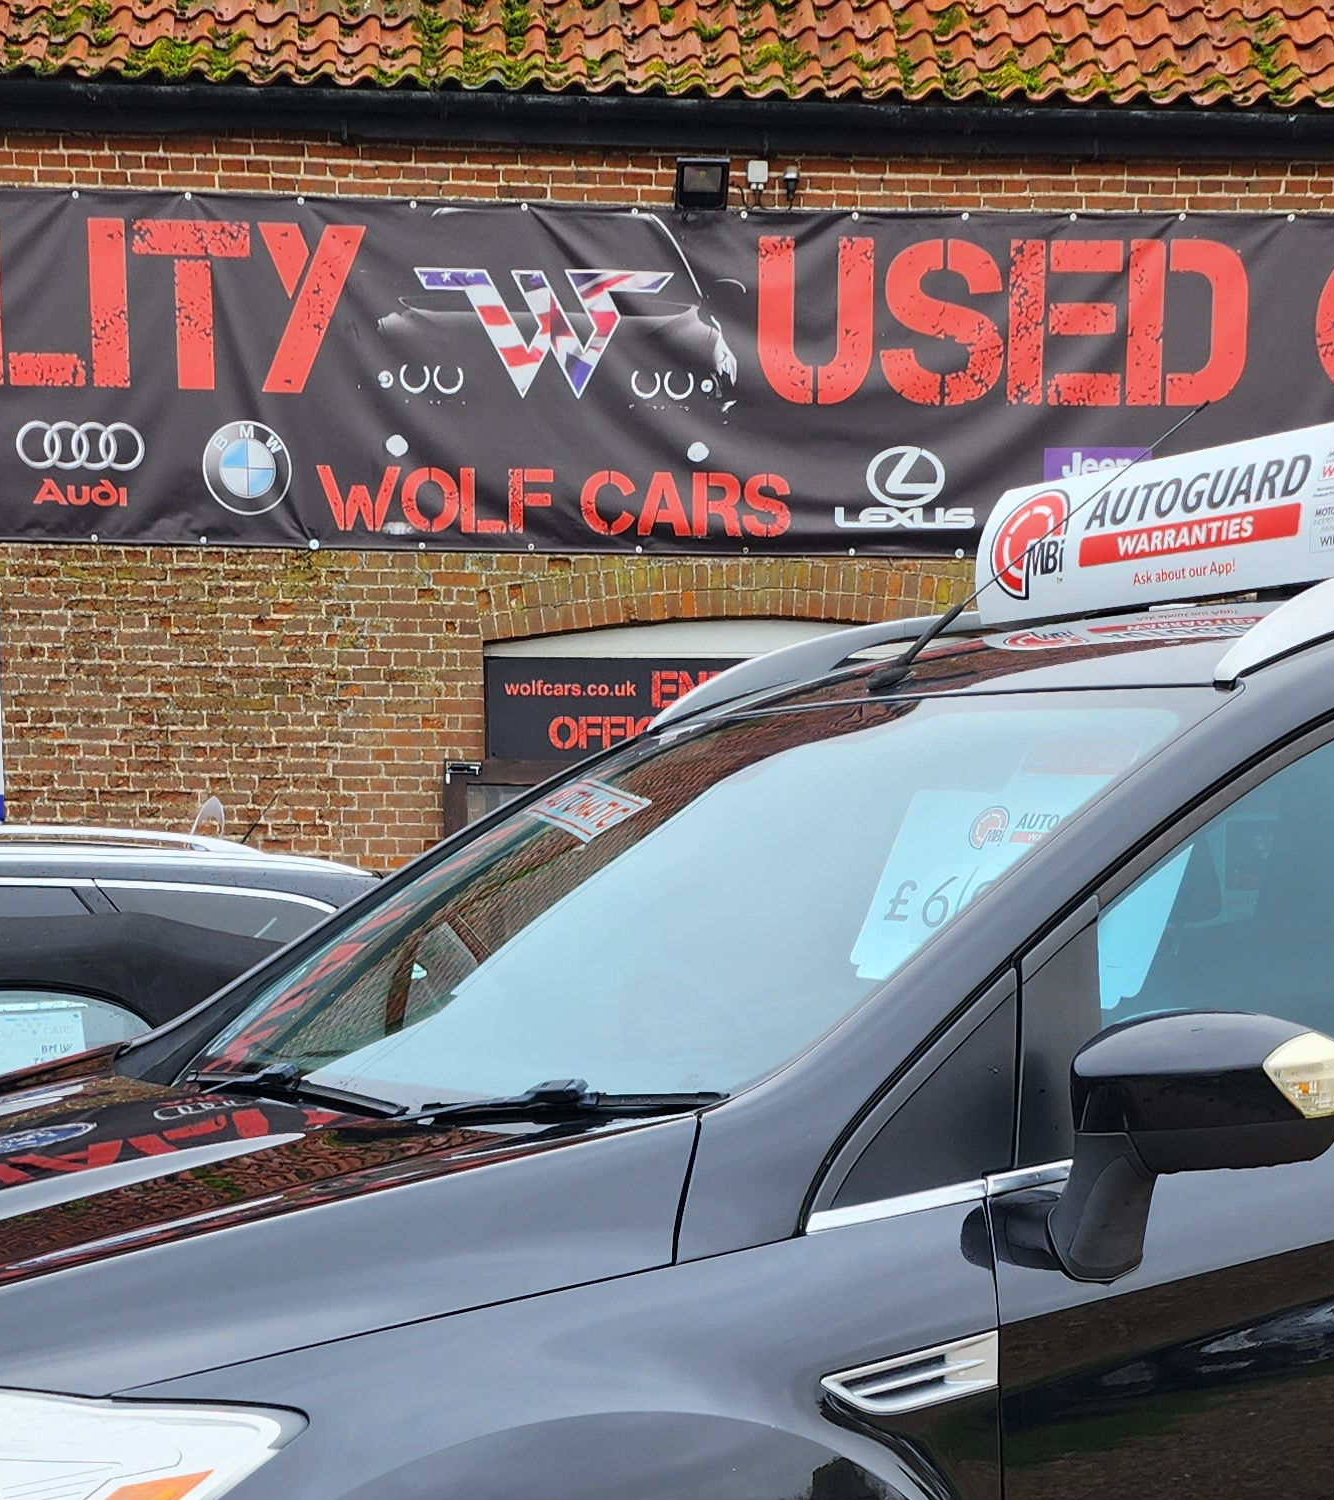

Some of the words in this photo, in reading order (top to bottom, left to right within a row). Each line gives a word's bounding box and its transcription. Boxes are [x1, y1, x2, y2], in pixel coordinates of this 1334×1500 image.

[756, 236, 1250, 406] USED
[213, 424, 282, 454] BMW
[33, 478, 128, 507] Audi
[317, 464, 553, 534] WOLF
[580, 470, 790, 538] CARS
[1084, 454, 1312, 530] AUTOGUARD
[834, 506, 975, 529] LEXUS
[1117, 516, 1254, 556] WARRANTIES
[1133, 570, 1153, 586] Ask
[1155, 566, 1186, 582] about
[1189, 566, 1207, 580] our
[1209, 560, 1237, 578] App!
[504, 679, 636, 697] wolfcars.co.uk
